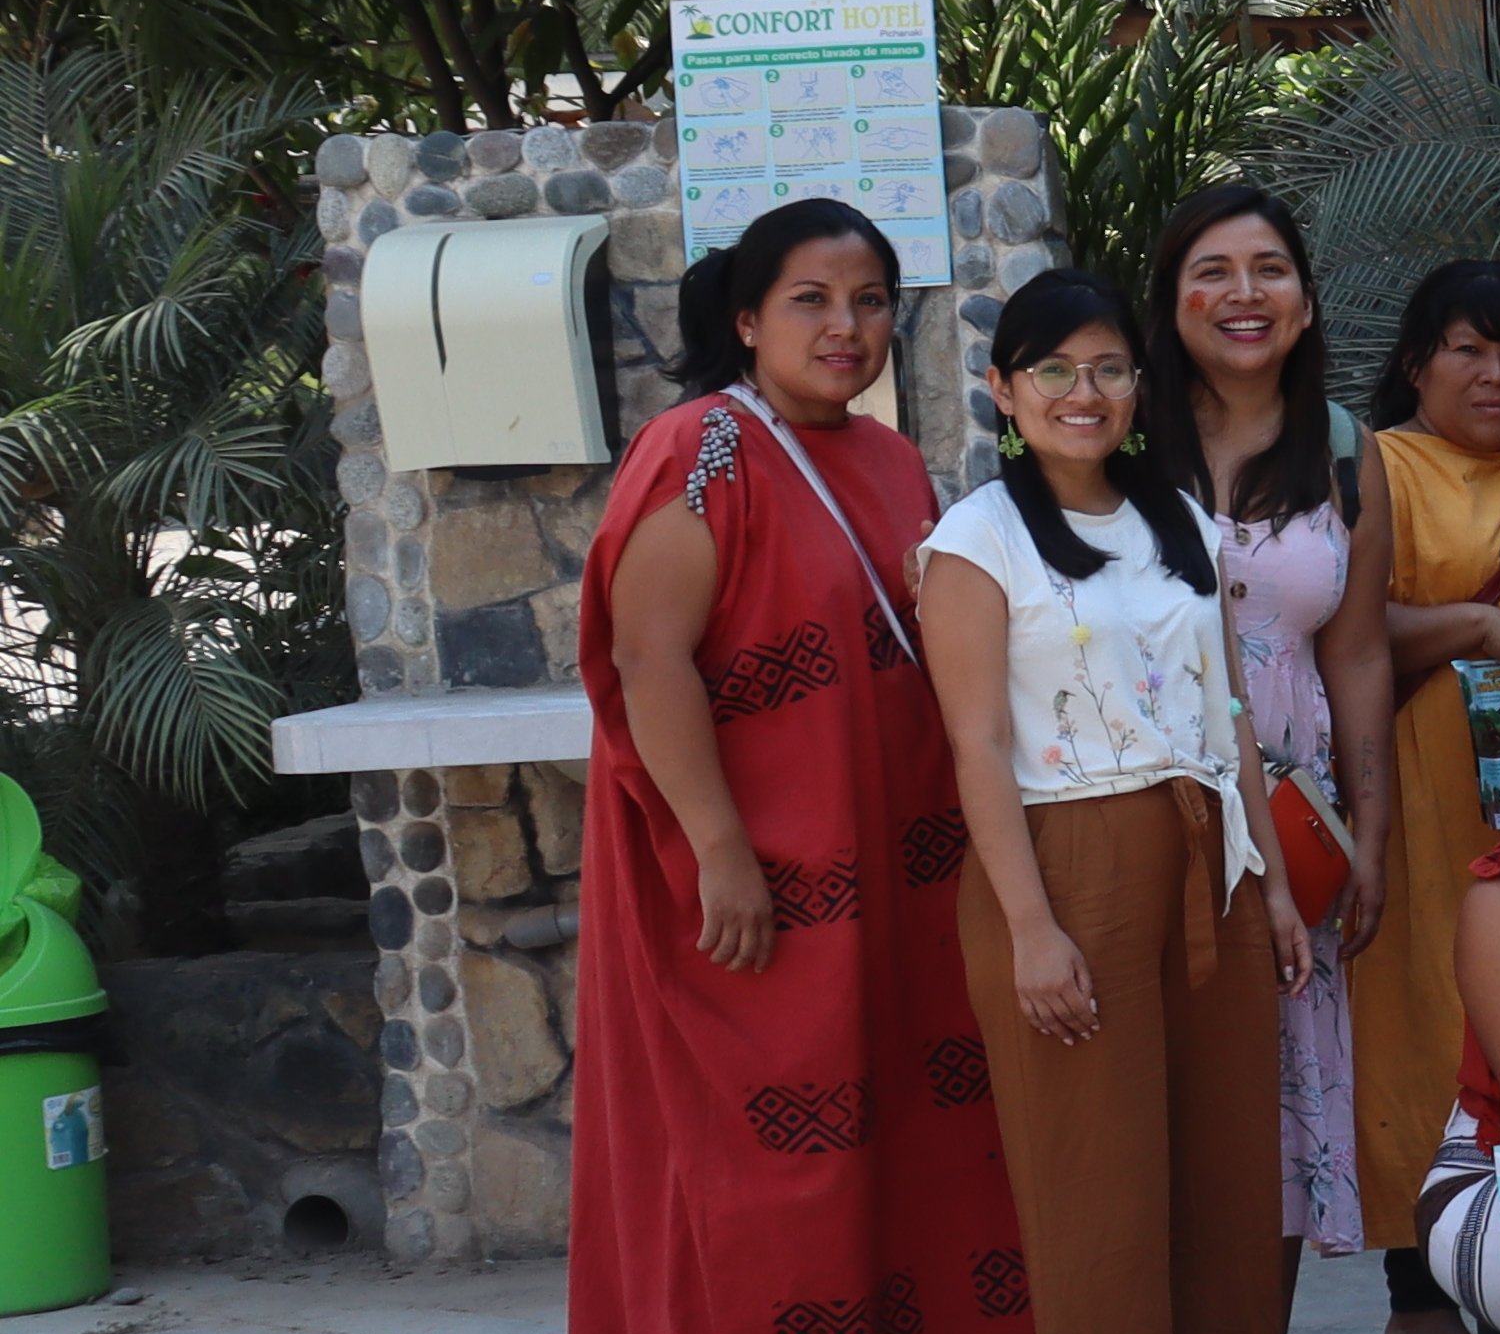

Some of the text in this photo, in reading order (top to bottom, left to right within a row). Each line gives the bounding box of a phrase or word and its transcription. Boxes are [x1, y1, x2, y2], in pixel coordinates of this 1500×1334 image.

[716, 1, 925, 36] CONFORT HOTEL
[687, 45, 919, 66] Pasos para un correcto lavado de manos
